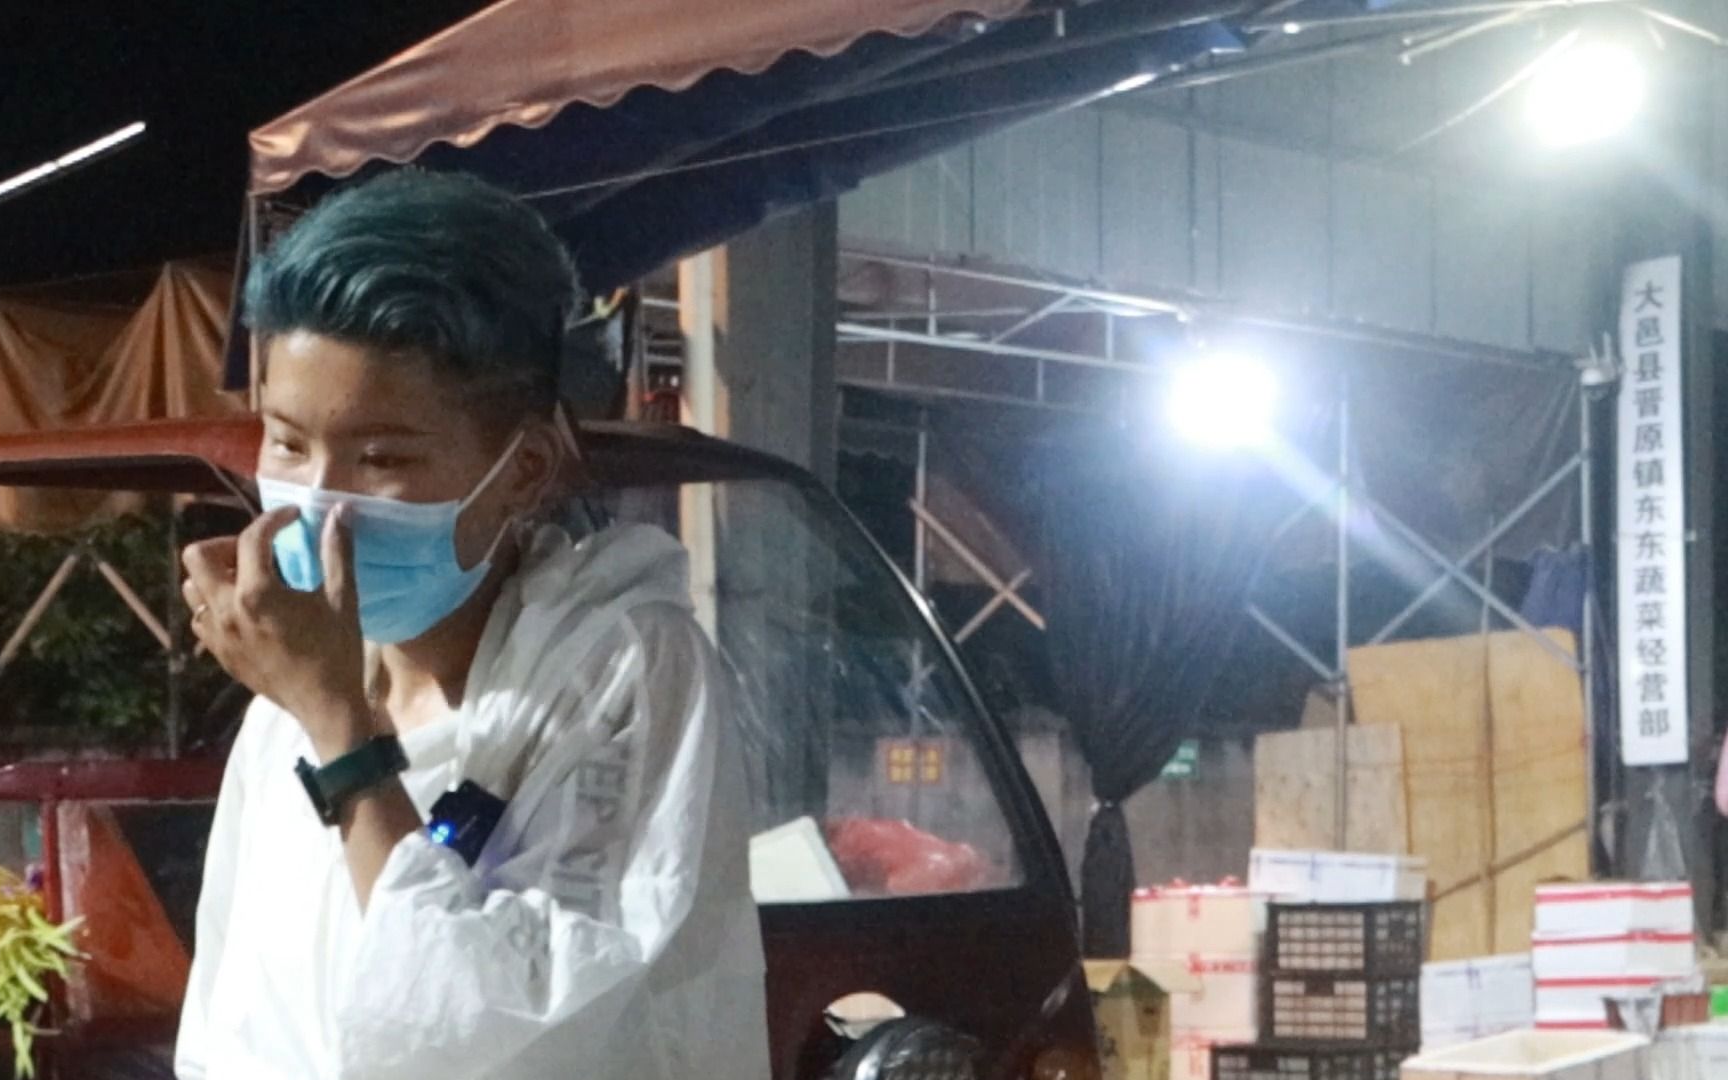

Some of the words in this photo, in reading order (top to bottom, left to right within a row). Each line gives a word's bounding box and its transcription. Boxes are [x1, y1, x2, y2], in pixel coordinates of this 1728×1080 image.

[1633, 279, 1670, 738] 大邑县晋原镇东东蔬菜经营部
